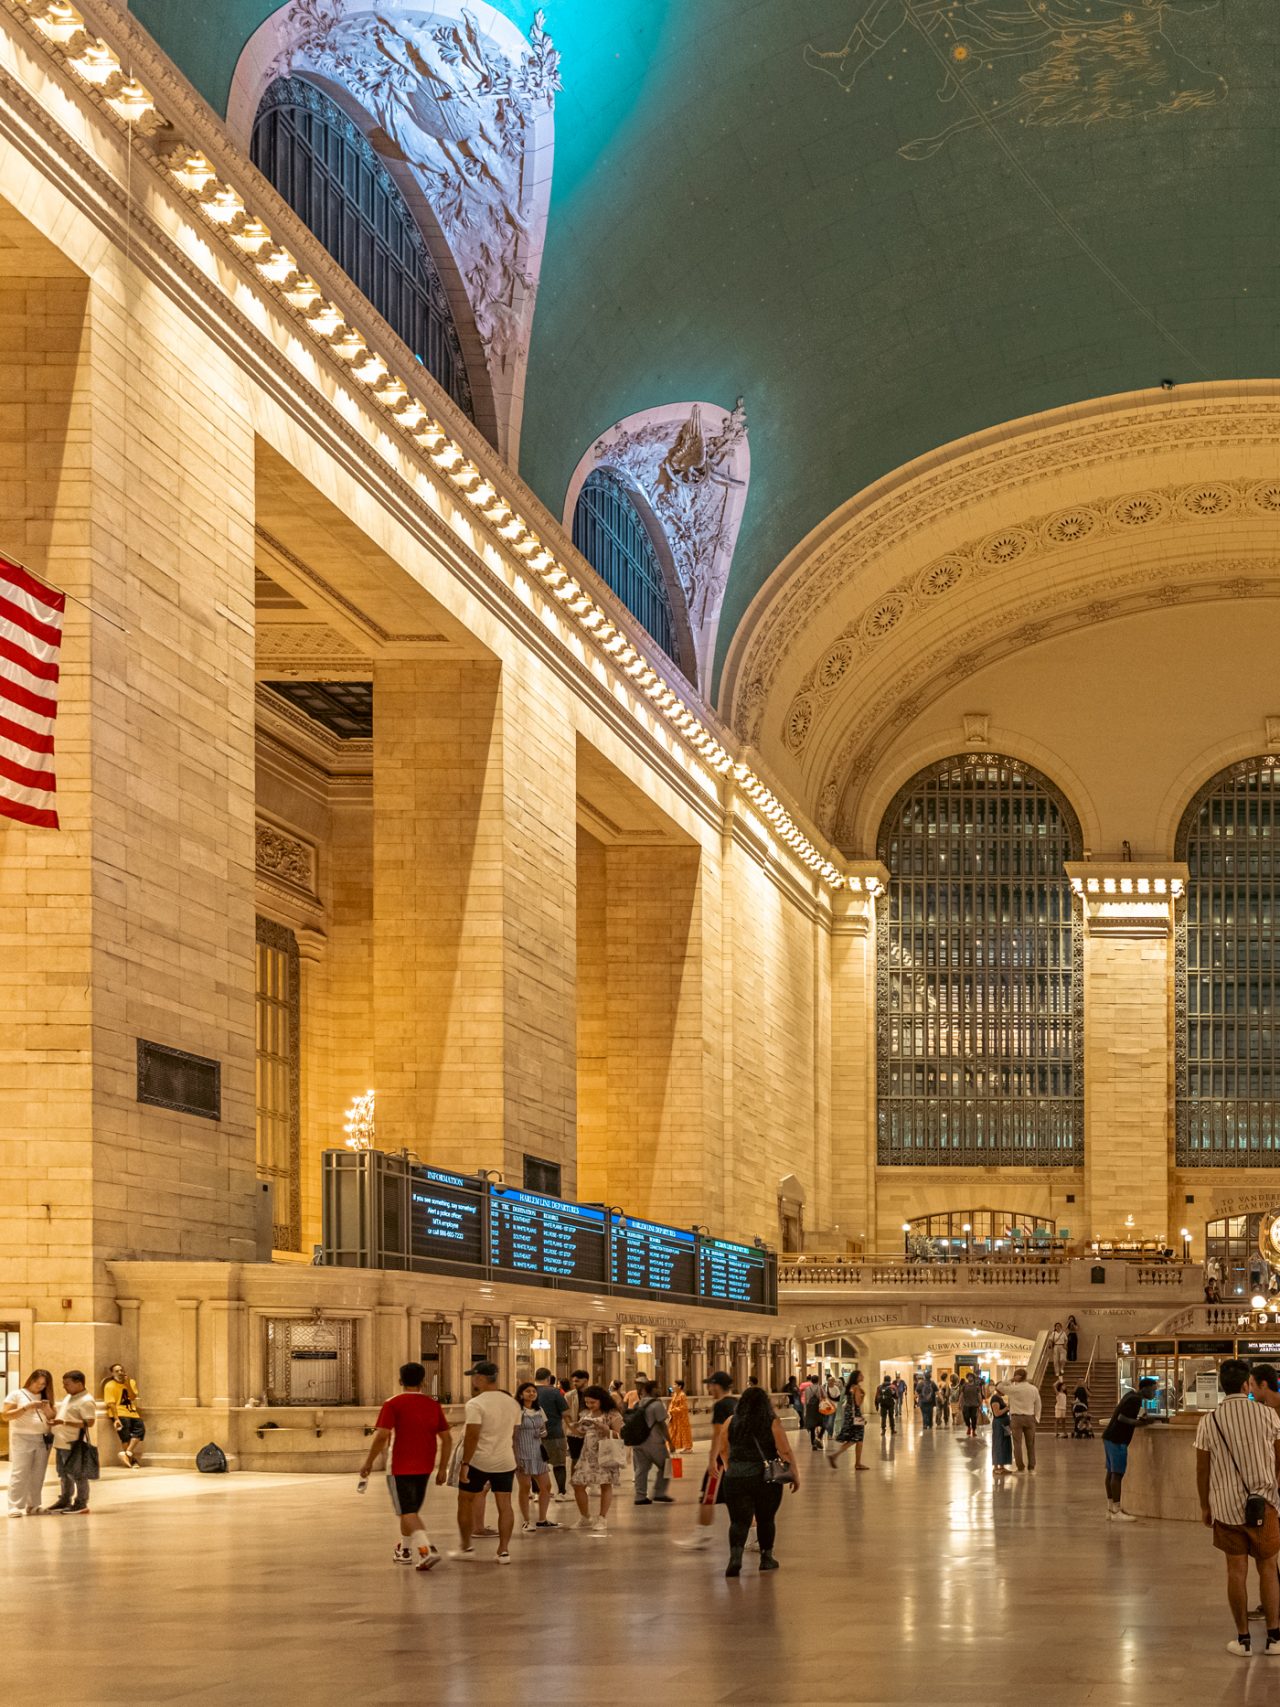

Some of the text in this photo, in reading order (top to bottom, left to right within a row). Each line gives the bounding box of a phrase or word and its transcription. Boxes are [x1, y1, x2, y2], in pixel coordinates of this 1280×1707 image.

[427, 1171, 463, 1186] INFORMATION
[519, 1193, 579, 1214] HARLEM LINE DEPARTURES
[1214, 1207, 1234, 1216] THE
[805, 1313, 898, 1333] TICKET MACHINES
[931, 1315, 1017, 1332] SUBWAY 42ND ST
[928, 1342, 960, 1350] SUBWAY
[962, 1341, 998, 1349] SHUTTLE
